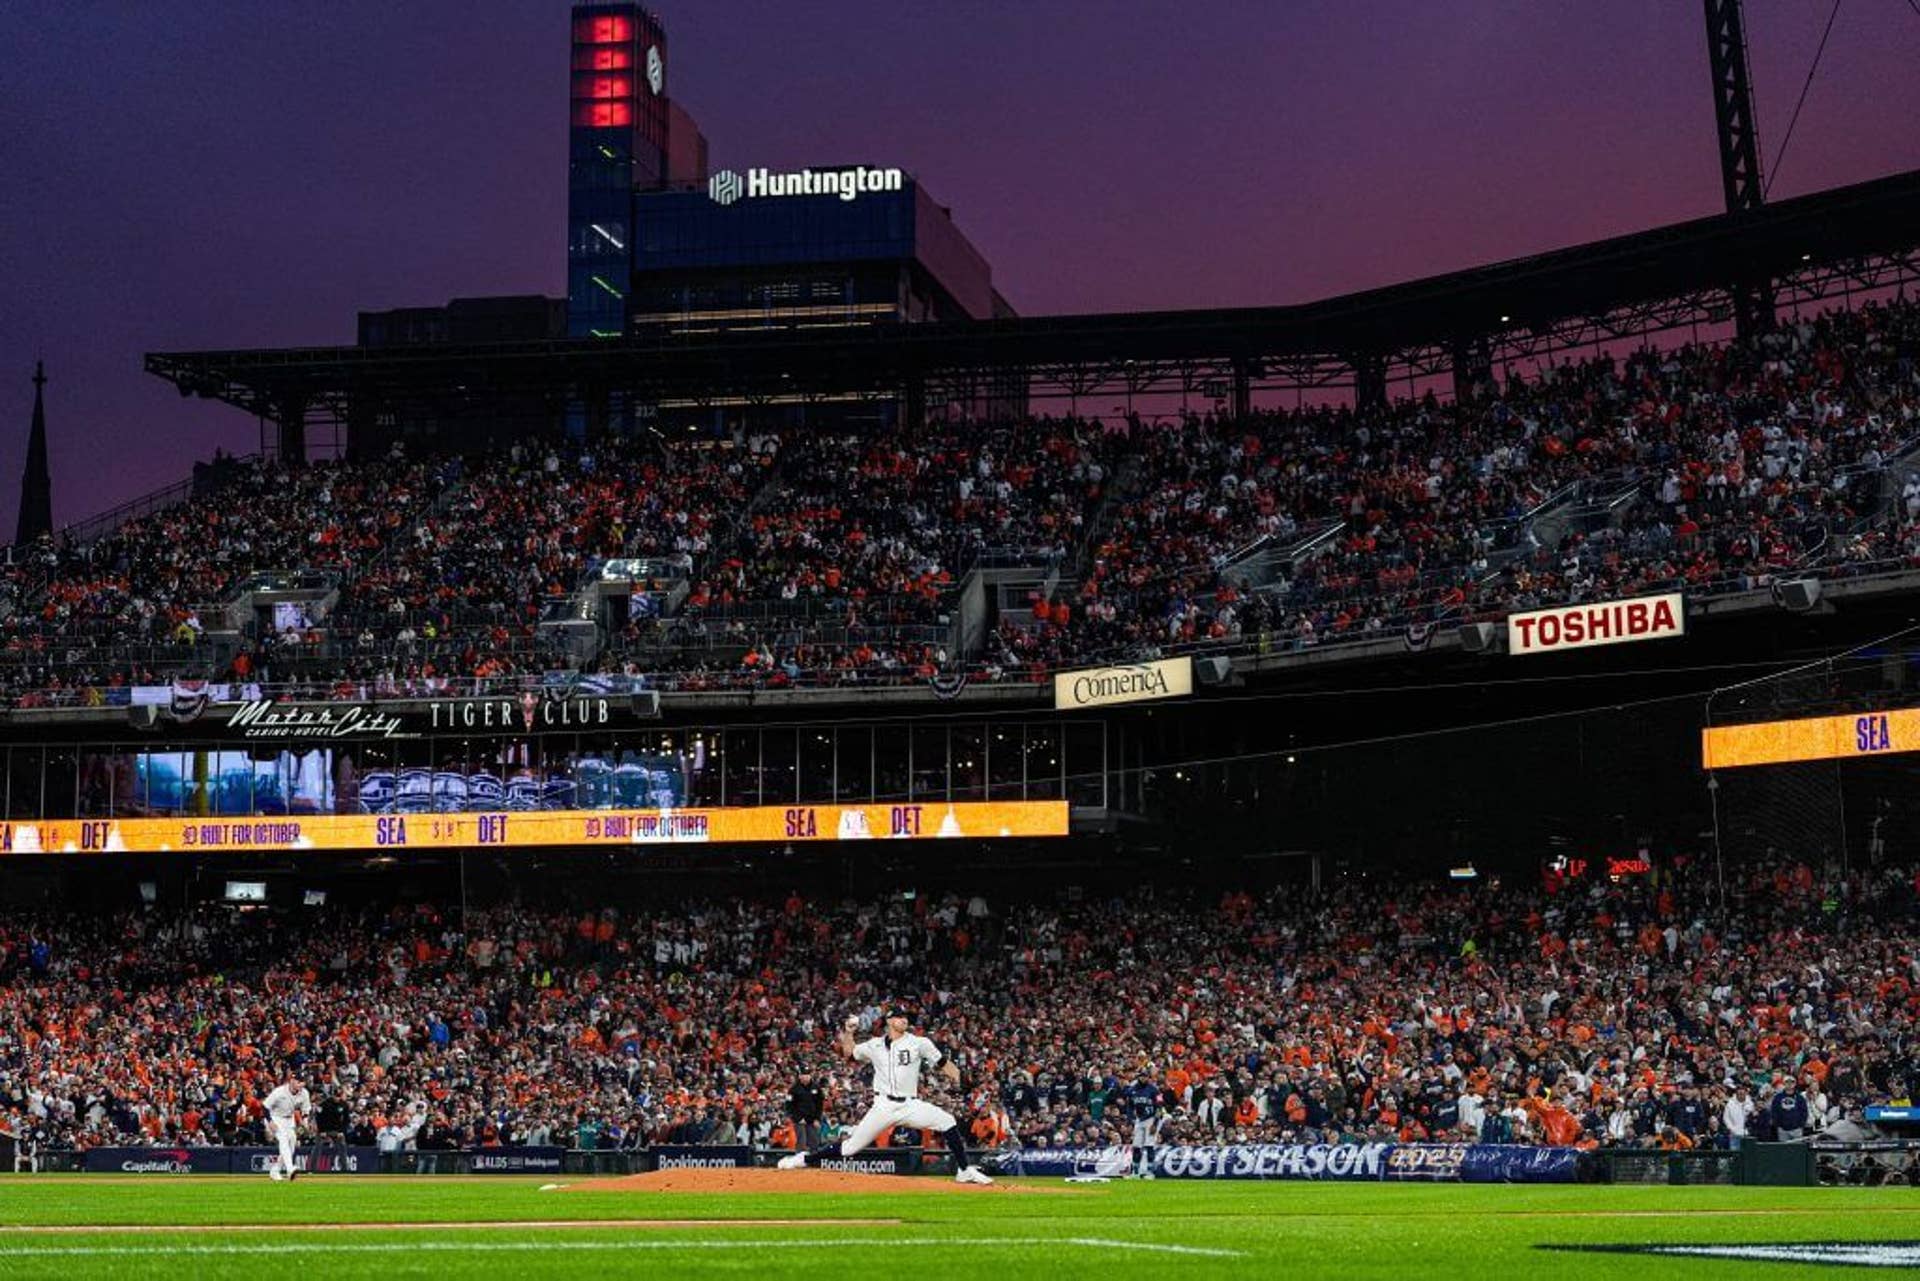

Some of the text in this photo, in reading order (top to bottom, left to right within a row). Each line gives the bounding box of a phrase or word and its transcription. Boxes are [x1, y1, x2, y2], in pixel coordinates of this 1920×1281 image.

[748, 166, 902, 201] Huntington
[1515, 600, 1676, 648] TOSHIBA
[226, 699, 421, 737] Motor City
[430, 699, 609, 727] TIGER CLUB
[1856, 715, 1890, 751] SEA
[200, 825, 229, 845] BUILT
[232, 824, 251, 845] FOR
[253, 822, 301, 844] OCTOBER
[376, 817, 406, 845] SEA
[478, 815, 508, 843] DET
[604, 816, 634, 838] BUILT
[637, 815, 658, 837] FOR
[659, 815, 708, 837] OCTOBER
[785, 808, 817, 837] SEA
[892, 806, 922, 835] DET
[81, 822, 110, 850] DET
[658, 1154, 736, 1170] Booking.com
[820, 1156, 896, 1173] Booking.com
